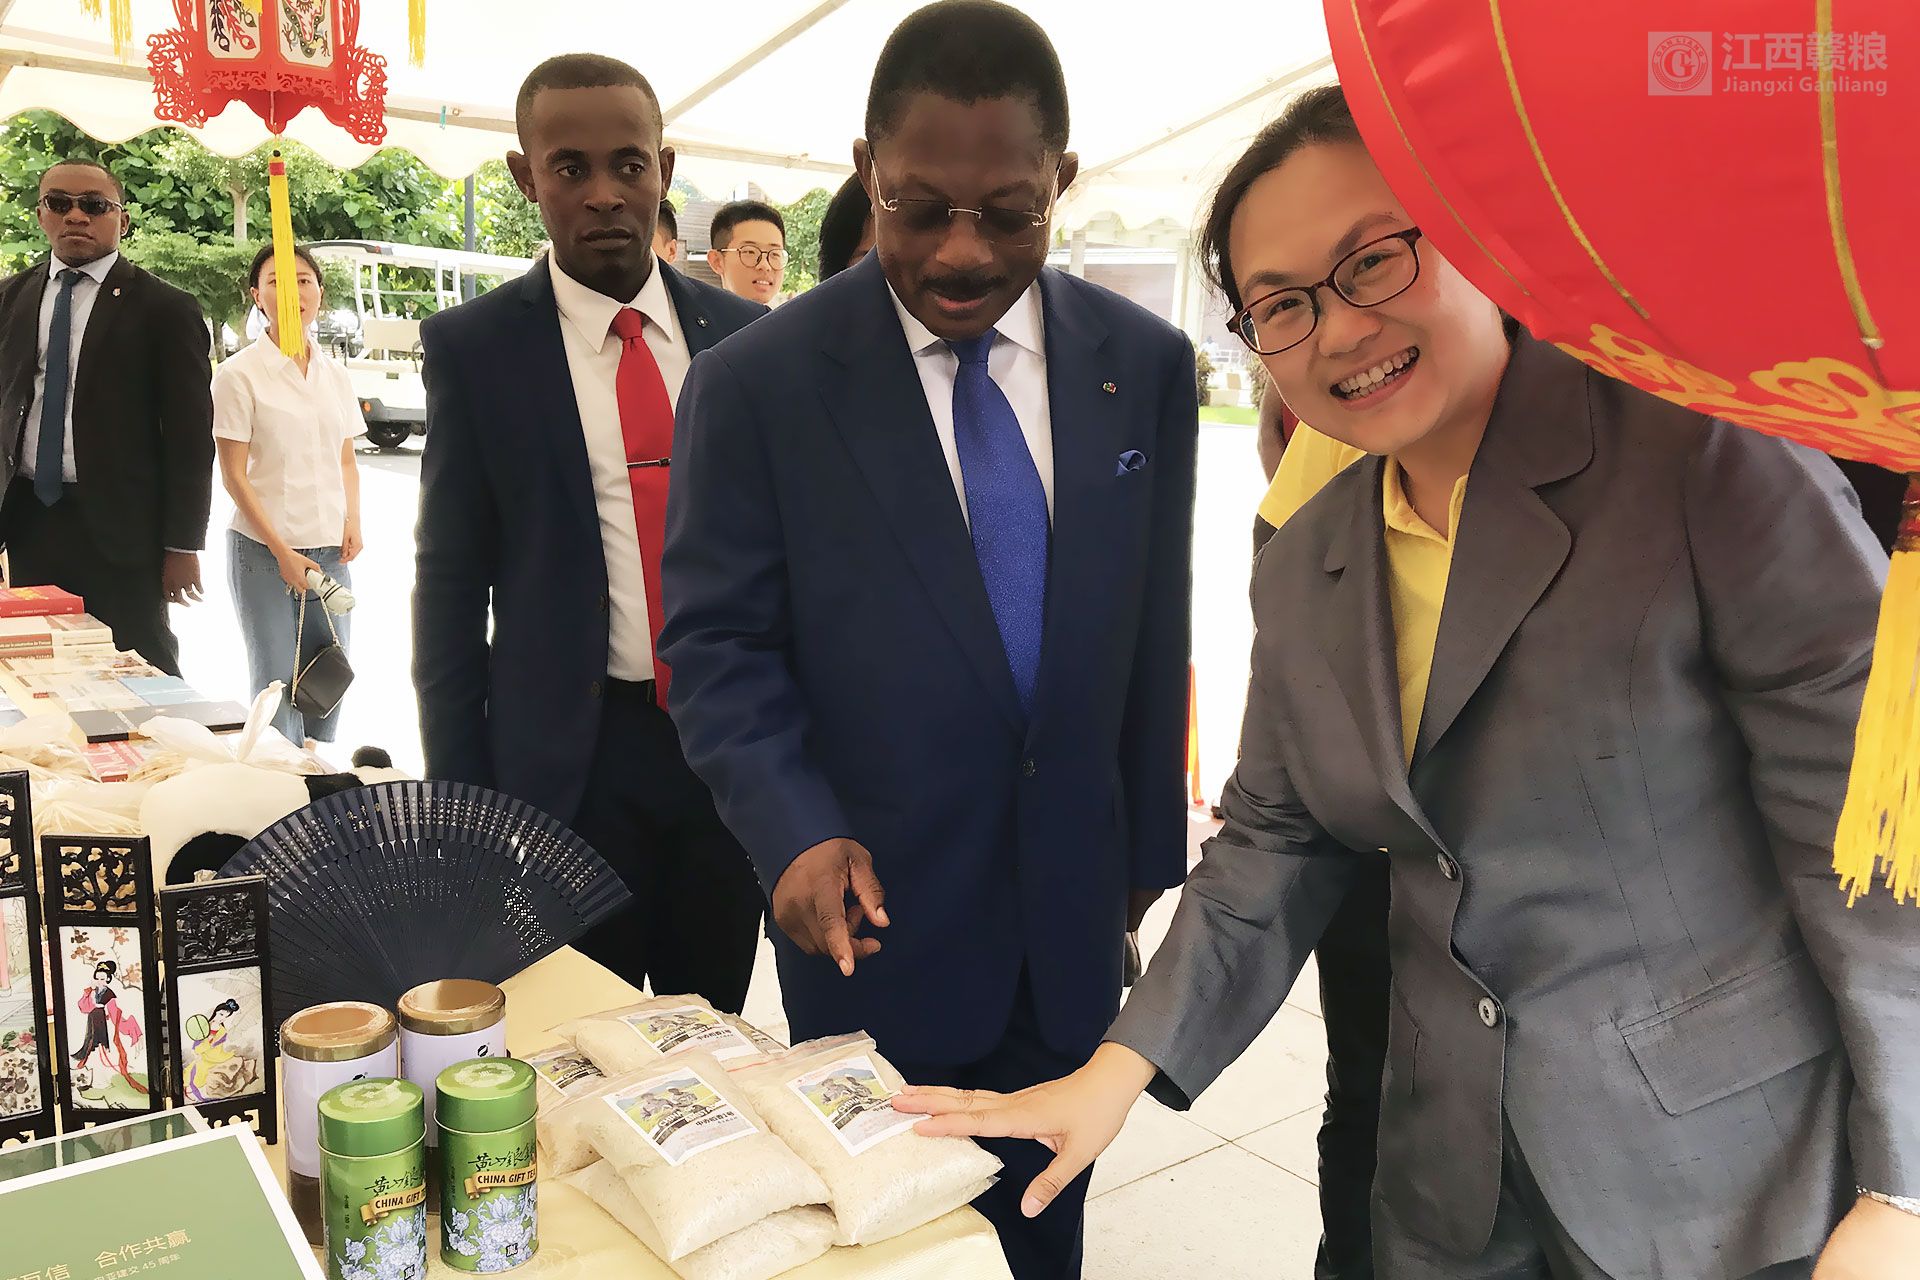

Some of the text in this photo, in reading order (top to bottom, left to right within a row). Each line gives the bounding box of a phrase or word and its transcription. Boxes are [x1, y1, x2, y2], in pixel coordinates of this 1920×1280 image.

[477, 1174, 506, 1184] CHINA
[508, 1172, 526, 1183] GIFT
[375, 1196, 403, 1209] CHINA
[406, 1191, 420, 1204] GIFT
[94, 1229, 192, 1269] 合作共赢
[142, 1260, 156, 1270] 45
